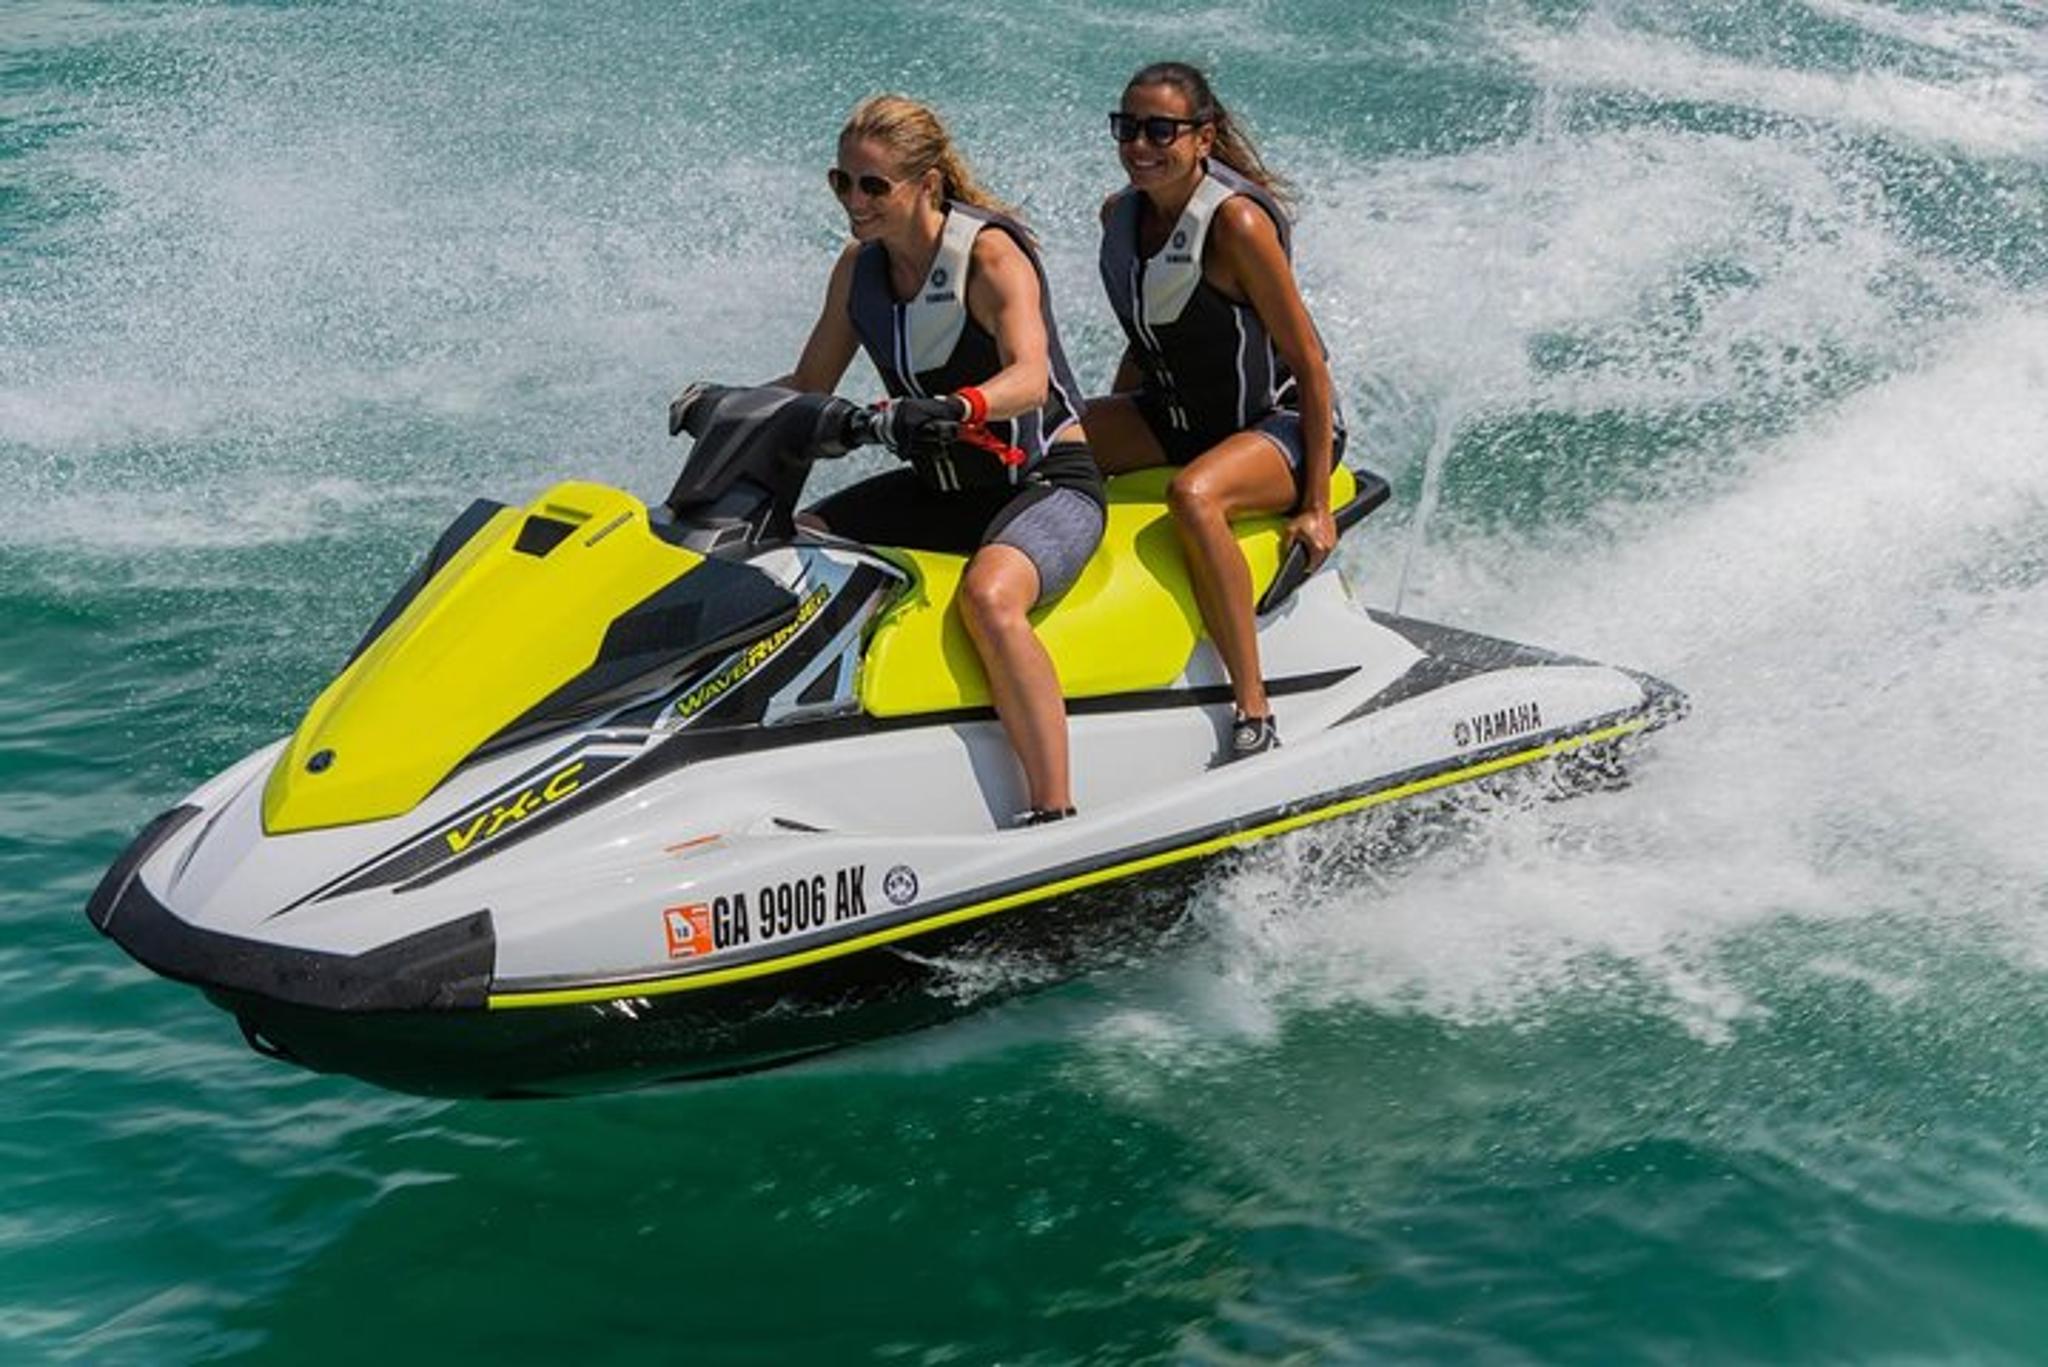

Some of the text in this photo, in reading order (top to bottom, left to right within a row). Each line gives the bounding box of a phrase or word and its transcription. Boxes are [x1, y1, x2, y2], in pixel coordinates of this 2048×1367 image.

[1471, 702, 1542, 743] YAMAHA
[447, 762, 585, 852] VX-C
[712, 893, 750, 949] GA
[760, 874, 826, 939] 9906
[835, 865, 867, 921] AK
